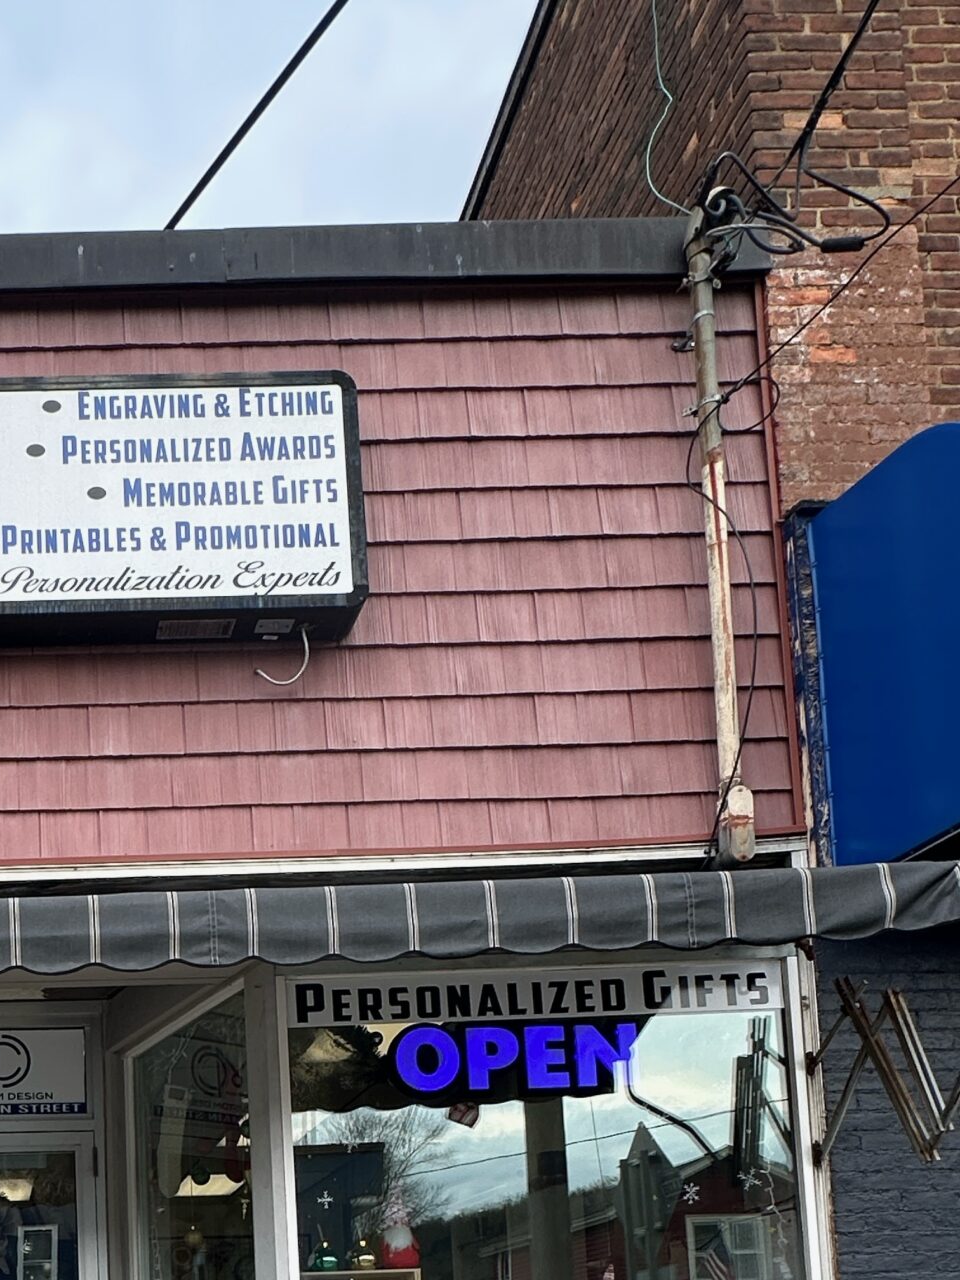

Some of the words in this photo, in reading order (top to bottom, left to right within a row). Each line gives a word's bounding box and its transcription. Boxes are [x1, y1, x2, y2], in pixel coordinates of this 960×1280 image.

[78, 391, 206, 420] ENGRAVING
[215, 393, 230, 417] &
[239, 388, 334, 416] ETCHING
[62, 435, 231, 464] PERSONALIZED
[240, 432, 336, 461] AWARDS
[123, 478, 265, 507] MEMORABLE
[272, 475, 338, 504] GIFTS
[2, 524, 142, 555] PRINTABLES
[149, 527, 166, 551] &
[175, 521, 339, 551] PROMOTIONAL
[233, 561, 341, 595] Experts
[295, 978, 628, 1024] PERSONALIZED
[642, 969, 769, 1009] GIFTS
[396, 1023, 639, 1092] OPEN
[8, 1092, 53, 1101] DESIGN
[19, 1104, 79, 1113] STREET
